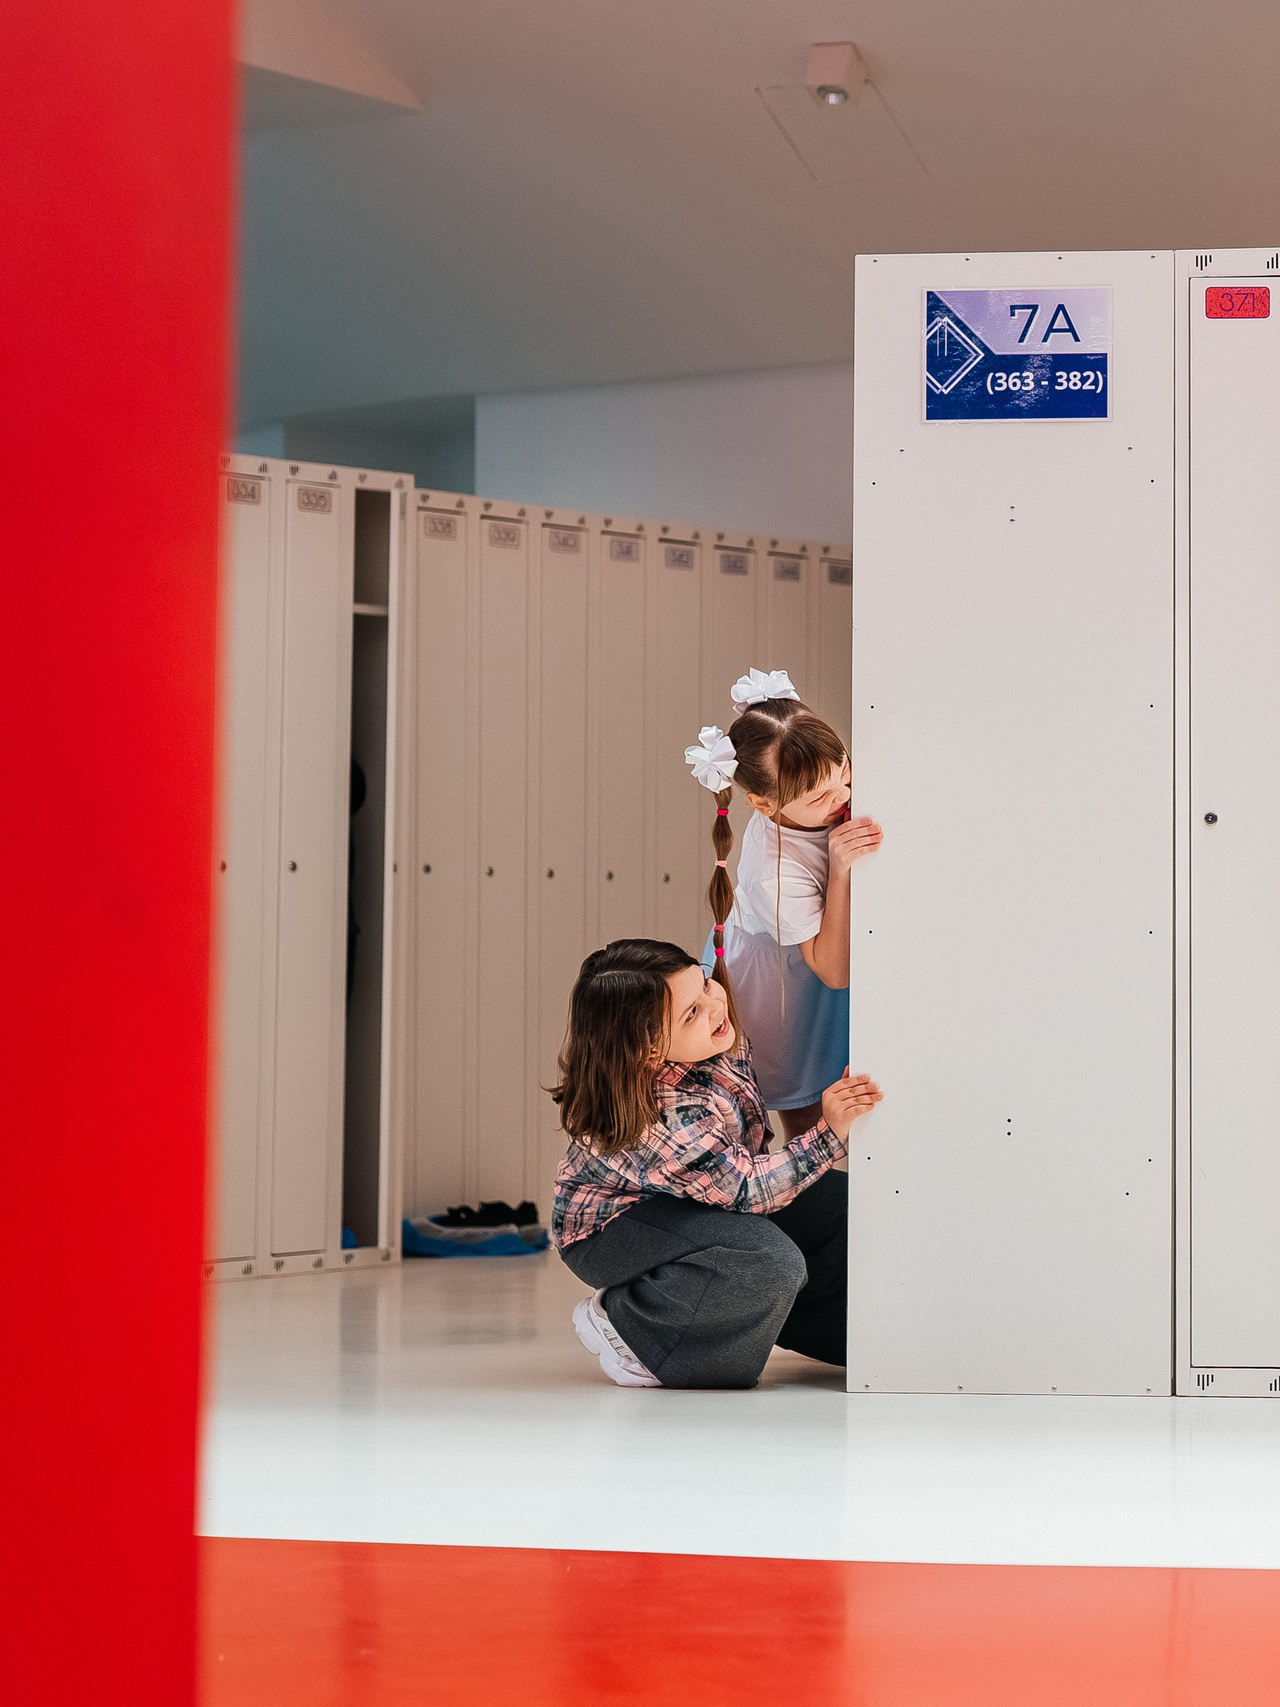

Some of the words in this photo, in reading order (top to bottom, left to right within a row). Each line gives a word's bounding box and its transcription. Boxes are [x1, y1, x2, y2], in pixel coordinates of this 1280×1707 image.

[1219, 292, 1256, 312] 371
[1009, 303, 1082, 344] 7А
[986, 372, 1035, 395] (363
[1054, 371, 1104, 394] 382)
